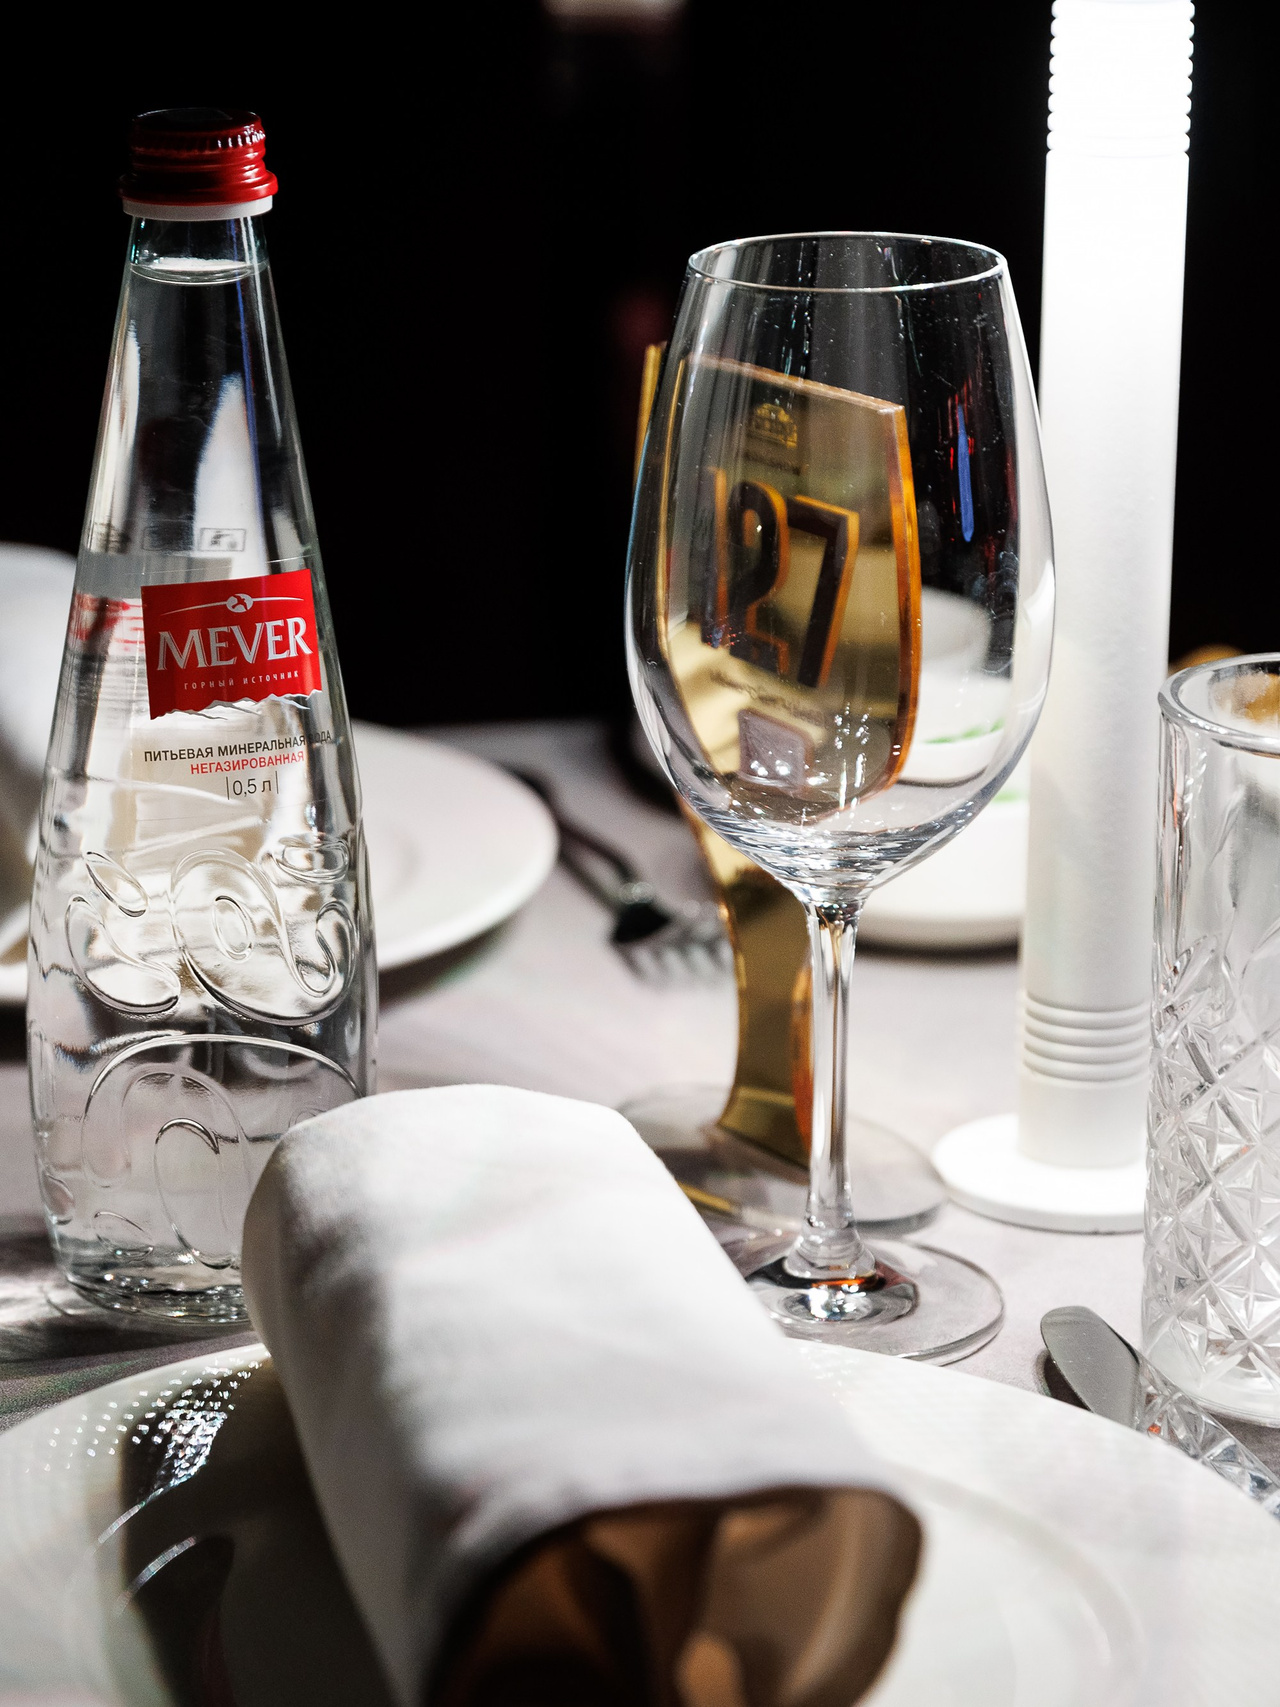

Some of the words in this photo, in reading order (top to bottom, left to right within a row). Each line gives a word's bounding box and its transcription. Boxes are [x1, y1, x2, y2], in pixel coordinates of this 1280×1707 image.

[157, 617, 313, 671] MEVER
[183, 678, 235, 690] ГОРНЫЙ
[243, 670, 299, 685] ИСТОЧНИК
[144, 746, 214, 762] ПИТЬЕВАЯ
[218, 735, 306, 757] МИНЕРАЛЬНАЯ
[190, 750, 305, 774] НЕГАЗИРОВАННАЯ
[232, 778, 257, 797] 0,5
